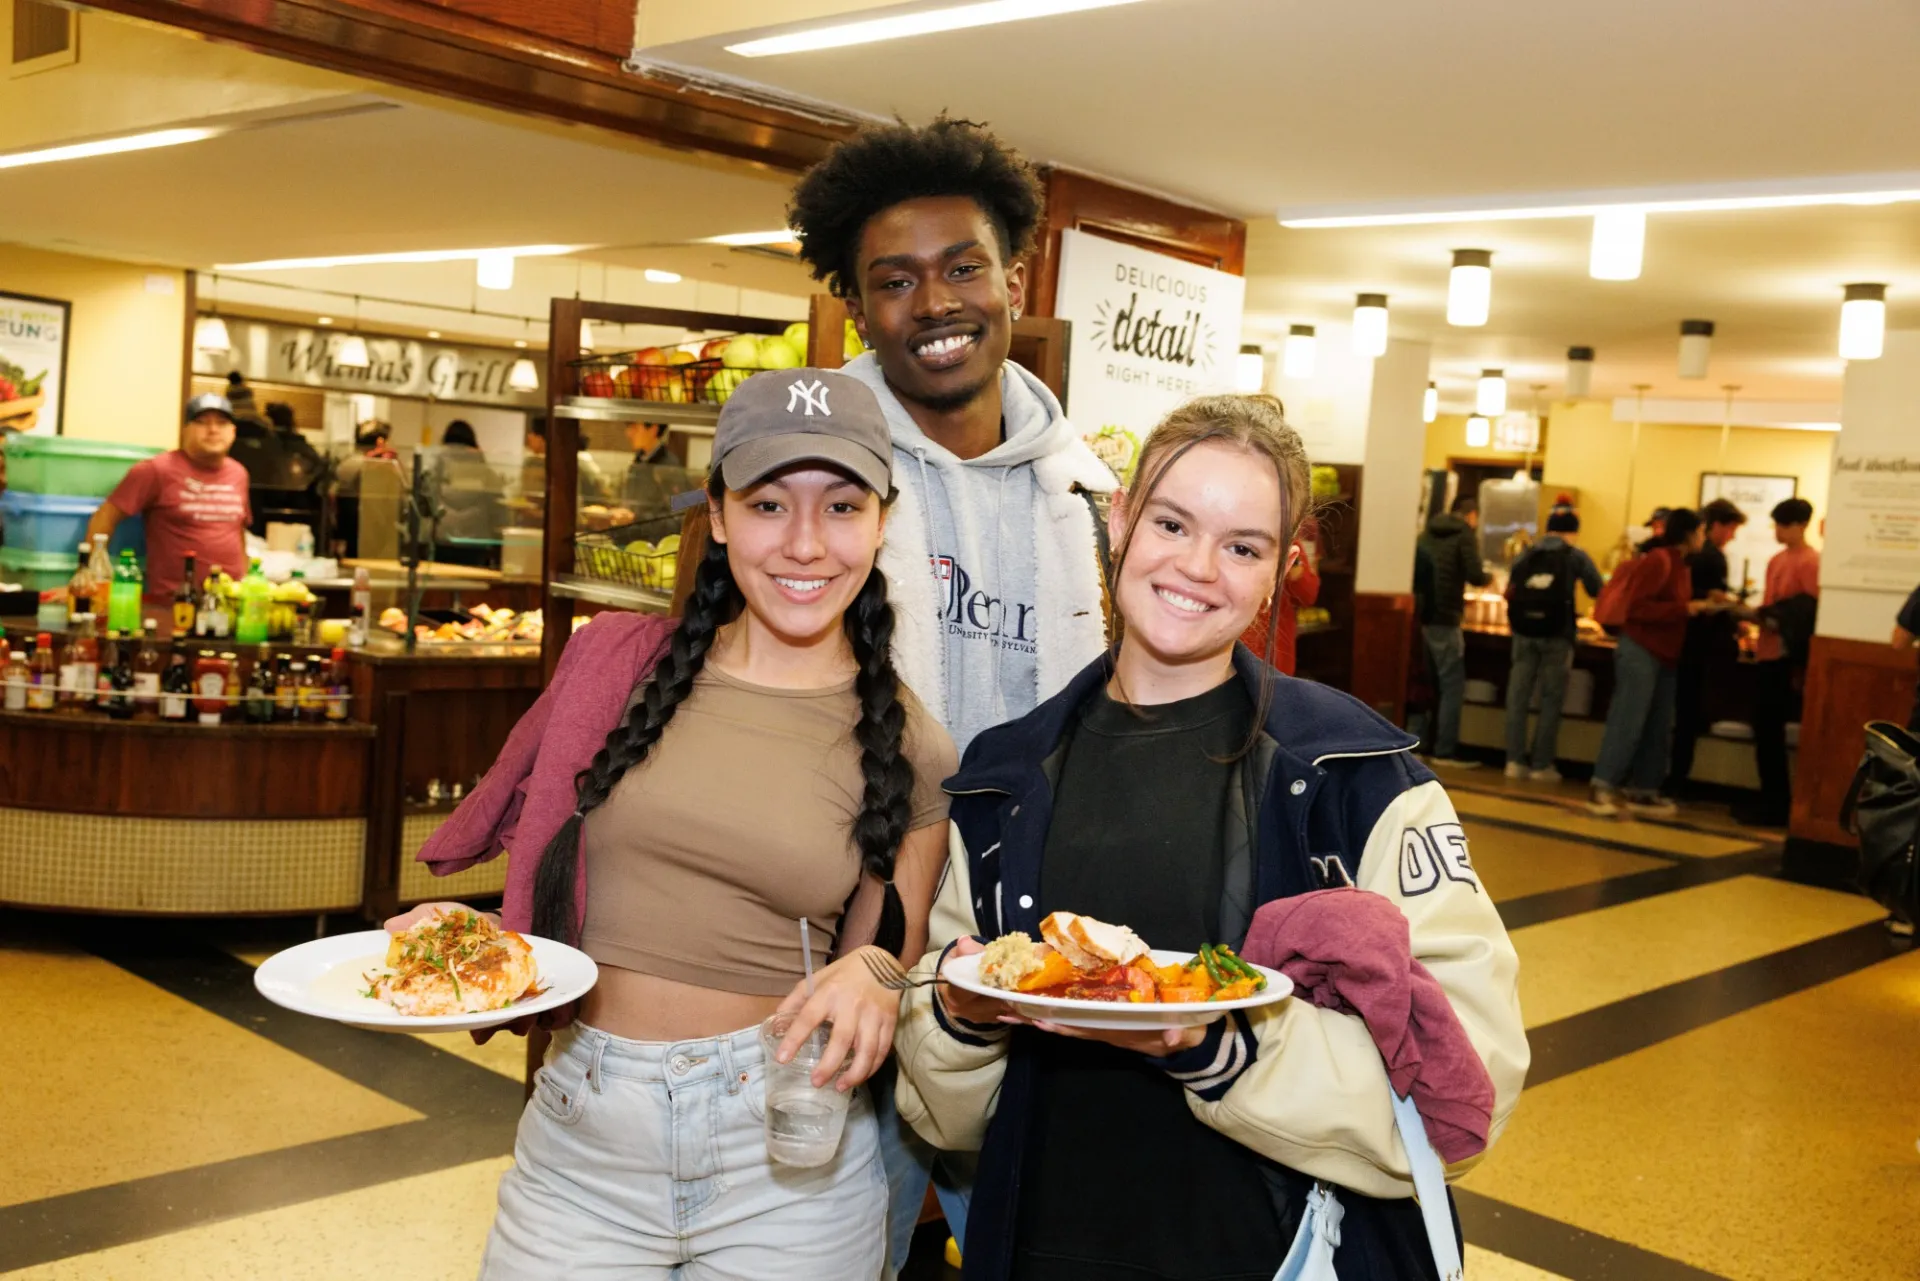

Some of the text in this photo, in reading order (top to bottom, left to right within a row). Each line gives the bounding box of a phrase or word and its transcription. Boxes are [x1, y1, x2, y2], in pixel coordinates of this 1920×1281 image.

[1115, 263, 1208, 304] DELICIOUS
[1112, 292, 1201, 367] detail
[427, 354, 515, 396] Grill
[1105, 364, 1150, 389] RIGHT
